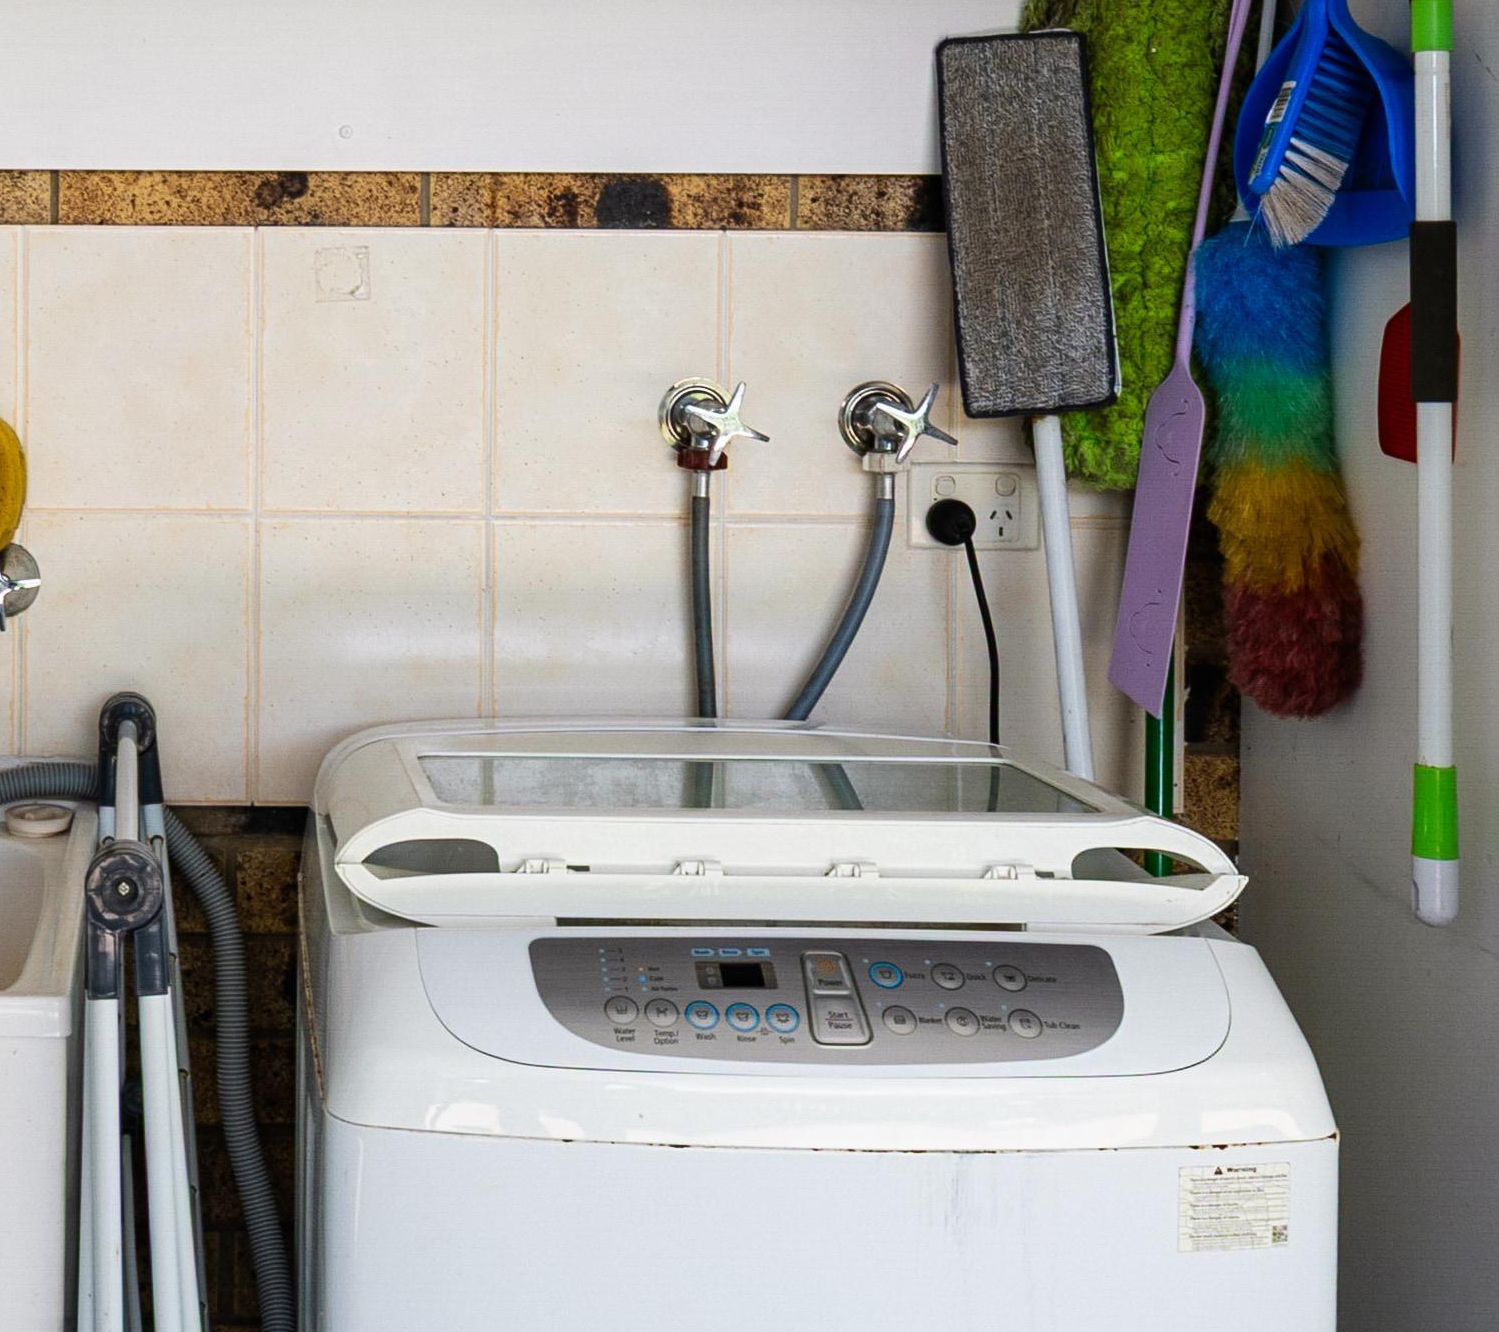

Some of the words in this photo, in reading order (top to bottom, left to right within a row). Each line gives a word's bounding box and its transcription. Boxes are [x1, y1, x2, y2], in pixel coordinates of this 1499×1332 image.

[826, 1010, 849, 1019] Start
[981, 1022, 1007, 1032] Saving
[1044, 1021, 1057, 1030] Tub
[1058, 1021, 1081, 1030] Clean
[613, 1027, 636, 1035] Water
[616, 1035, 636, 1043] Level
[695, 1032, 717, 1040] Wash
[736, 1035, 757, 1043] Rinse
[778, 1035, 796, 1045] Spin
[653, 1037, 680, 1045] Option
